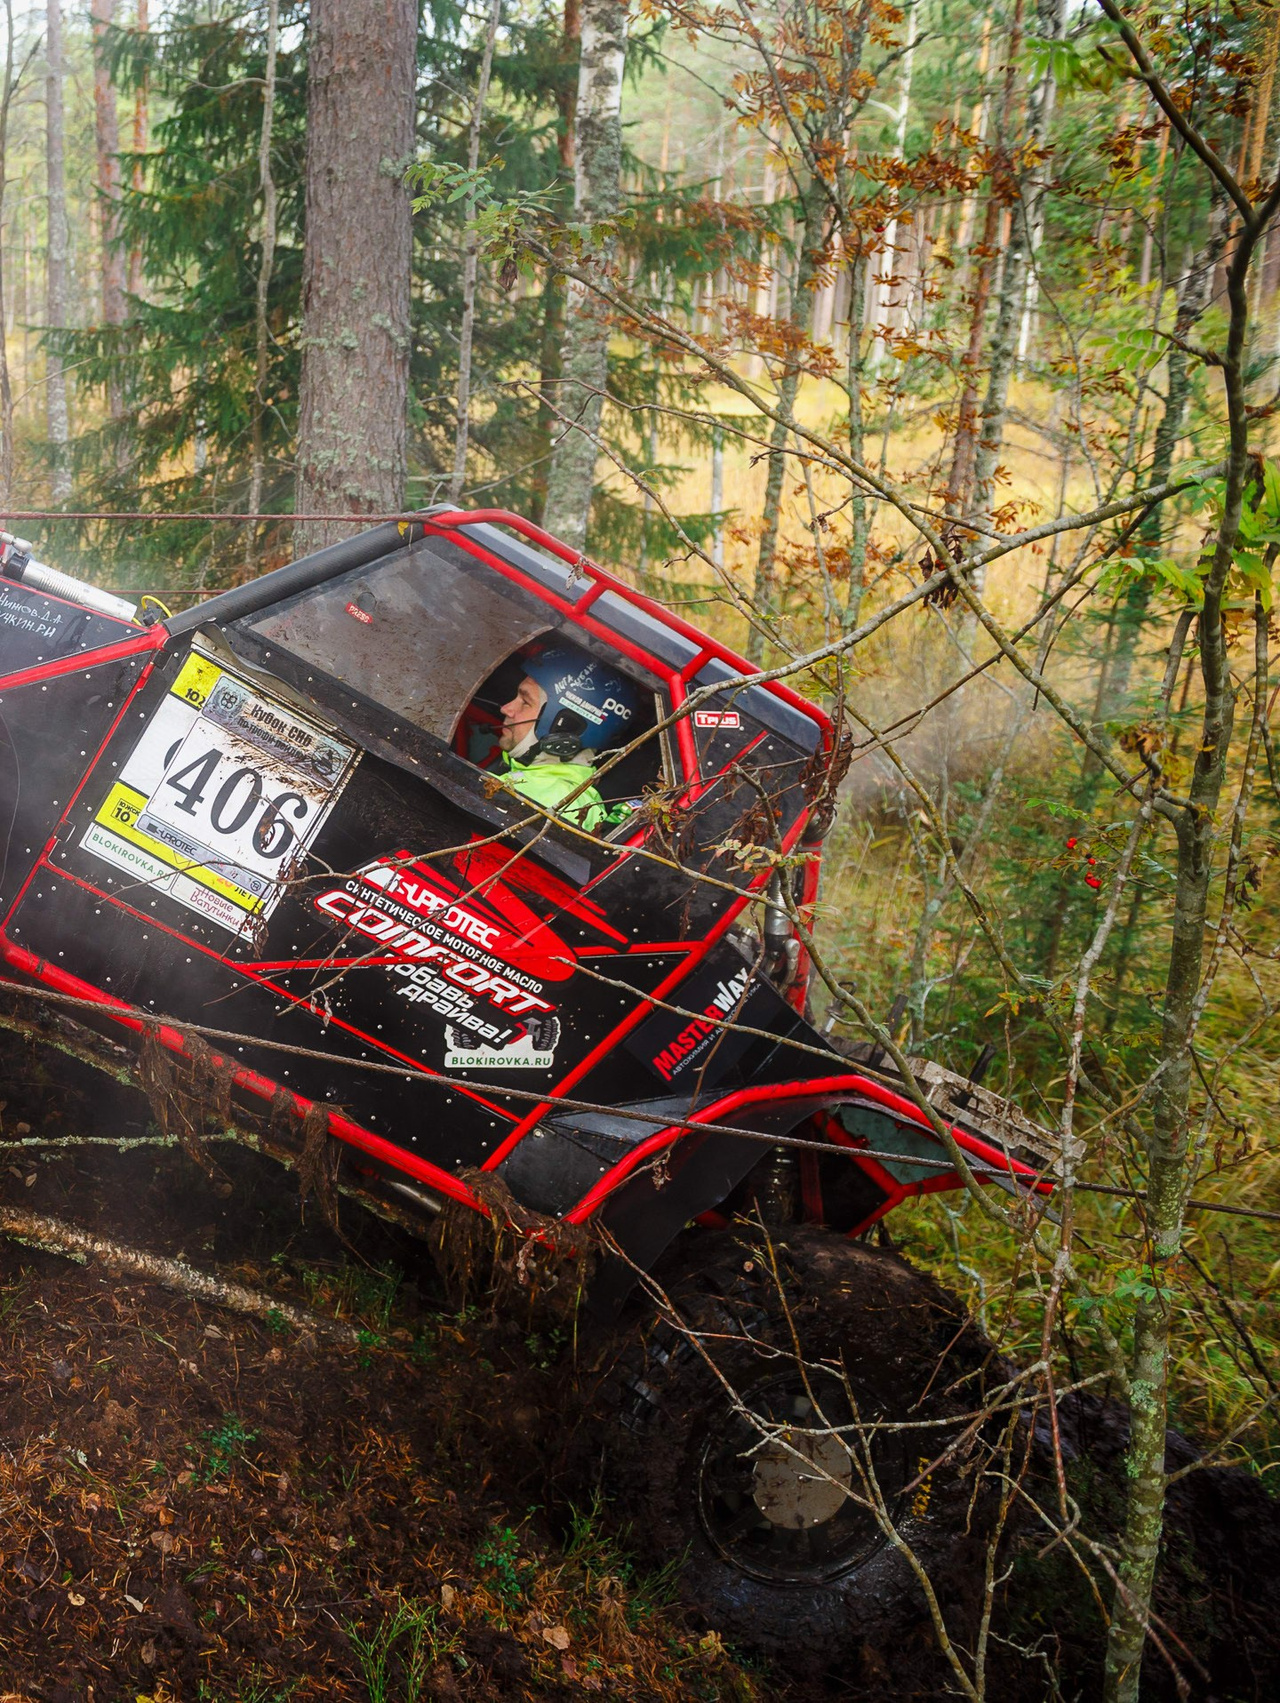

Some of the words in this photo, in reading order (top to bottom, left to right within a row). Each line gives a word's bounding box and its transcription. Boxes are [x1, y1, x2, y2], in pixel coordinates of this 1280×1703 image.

[348, 604, 370, 623] PRESS
[251, 703, 288, 734] Кубок
[166, 748, 308, 860] 406
[92, 833, 171, 882] BLOKIROVKA.RU
[190, 889, 240, 926] Ватутинки
[398, 877, 501, 950] SUPROTEC
[345, 880, 442, 940] СИНТЕТИЧЕСКОЕ
[502, 966, 544, 994] МАСЛО
[451, 1054, 552, 1067] BLOKIROVKA.RU
[673, 1039, 710, 1076] АВТОХИМИЯ
